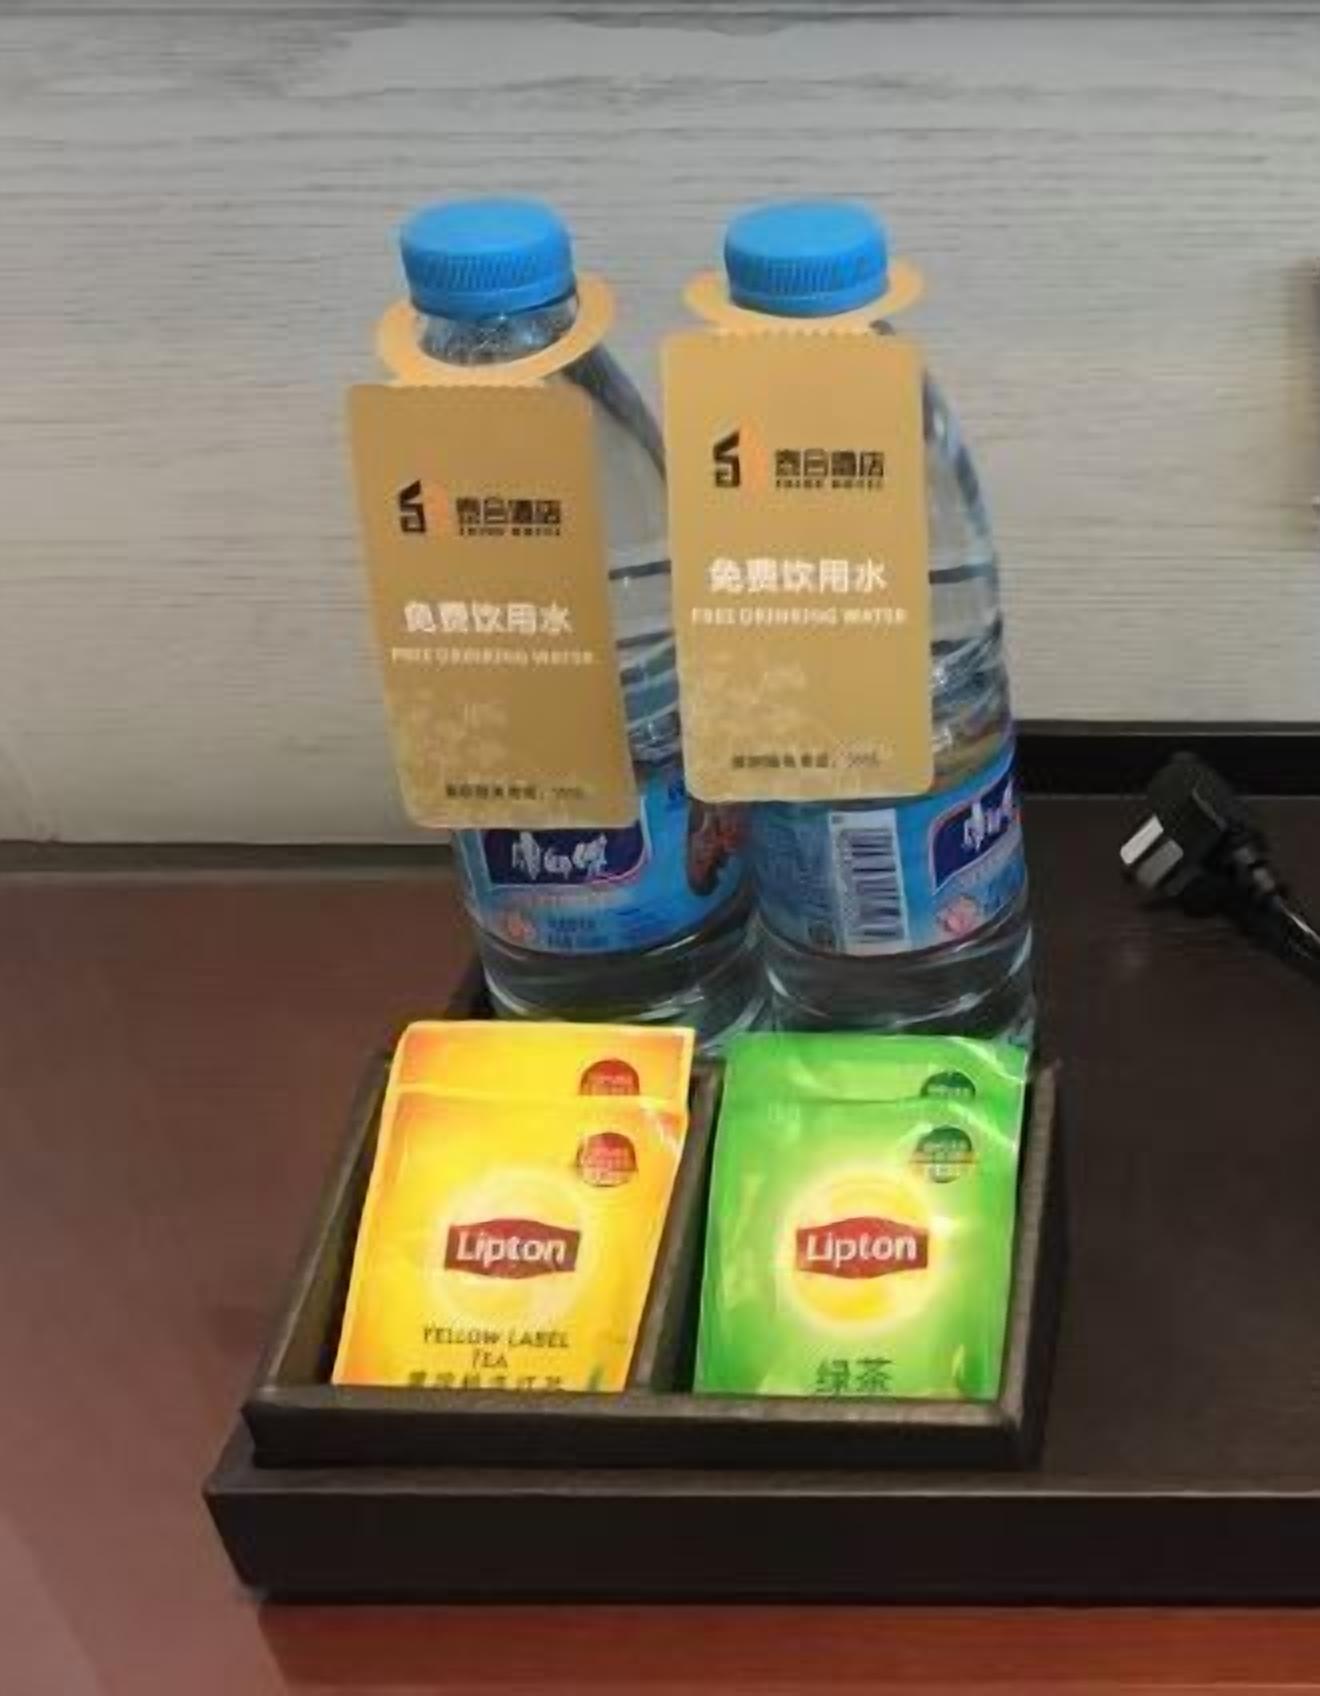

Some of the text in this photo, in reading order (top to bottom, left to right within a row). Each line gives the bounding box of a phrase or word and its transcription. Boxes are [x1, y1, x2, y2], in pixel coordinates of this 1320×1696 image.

[708, 556, 890, 593] 免费饮用水
[403, 600, 574, 634] 免费饮用水
[455, 1229, 568, 1269] Lipton
[806, 1231, 918, 1269] Lipton
[423, 1326, 570, 1349] YELLOW LABEL
[472, 1349, 509, 1369] TEA
[815, 1358, 893, 1396] 绿茶
